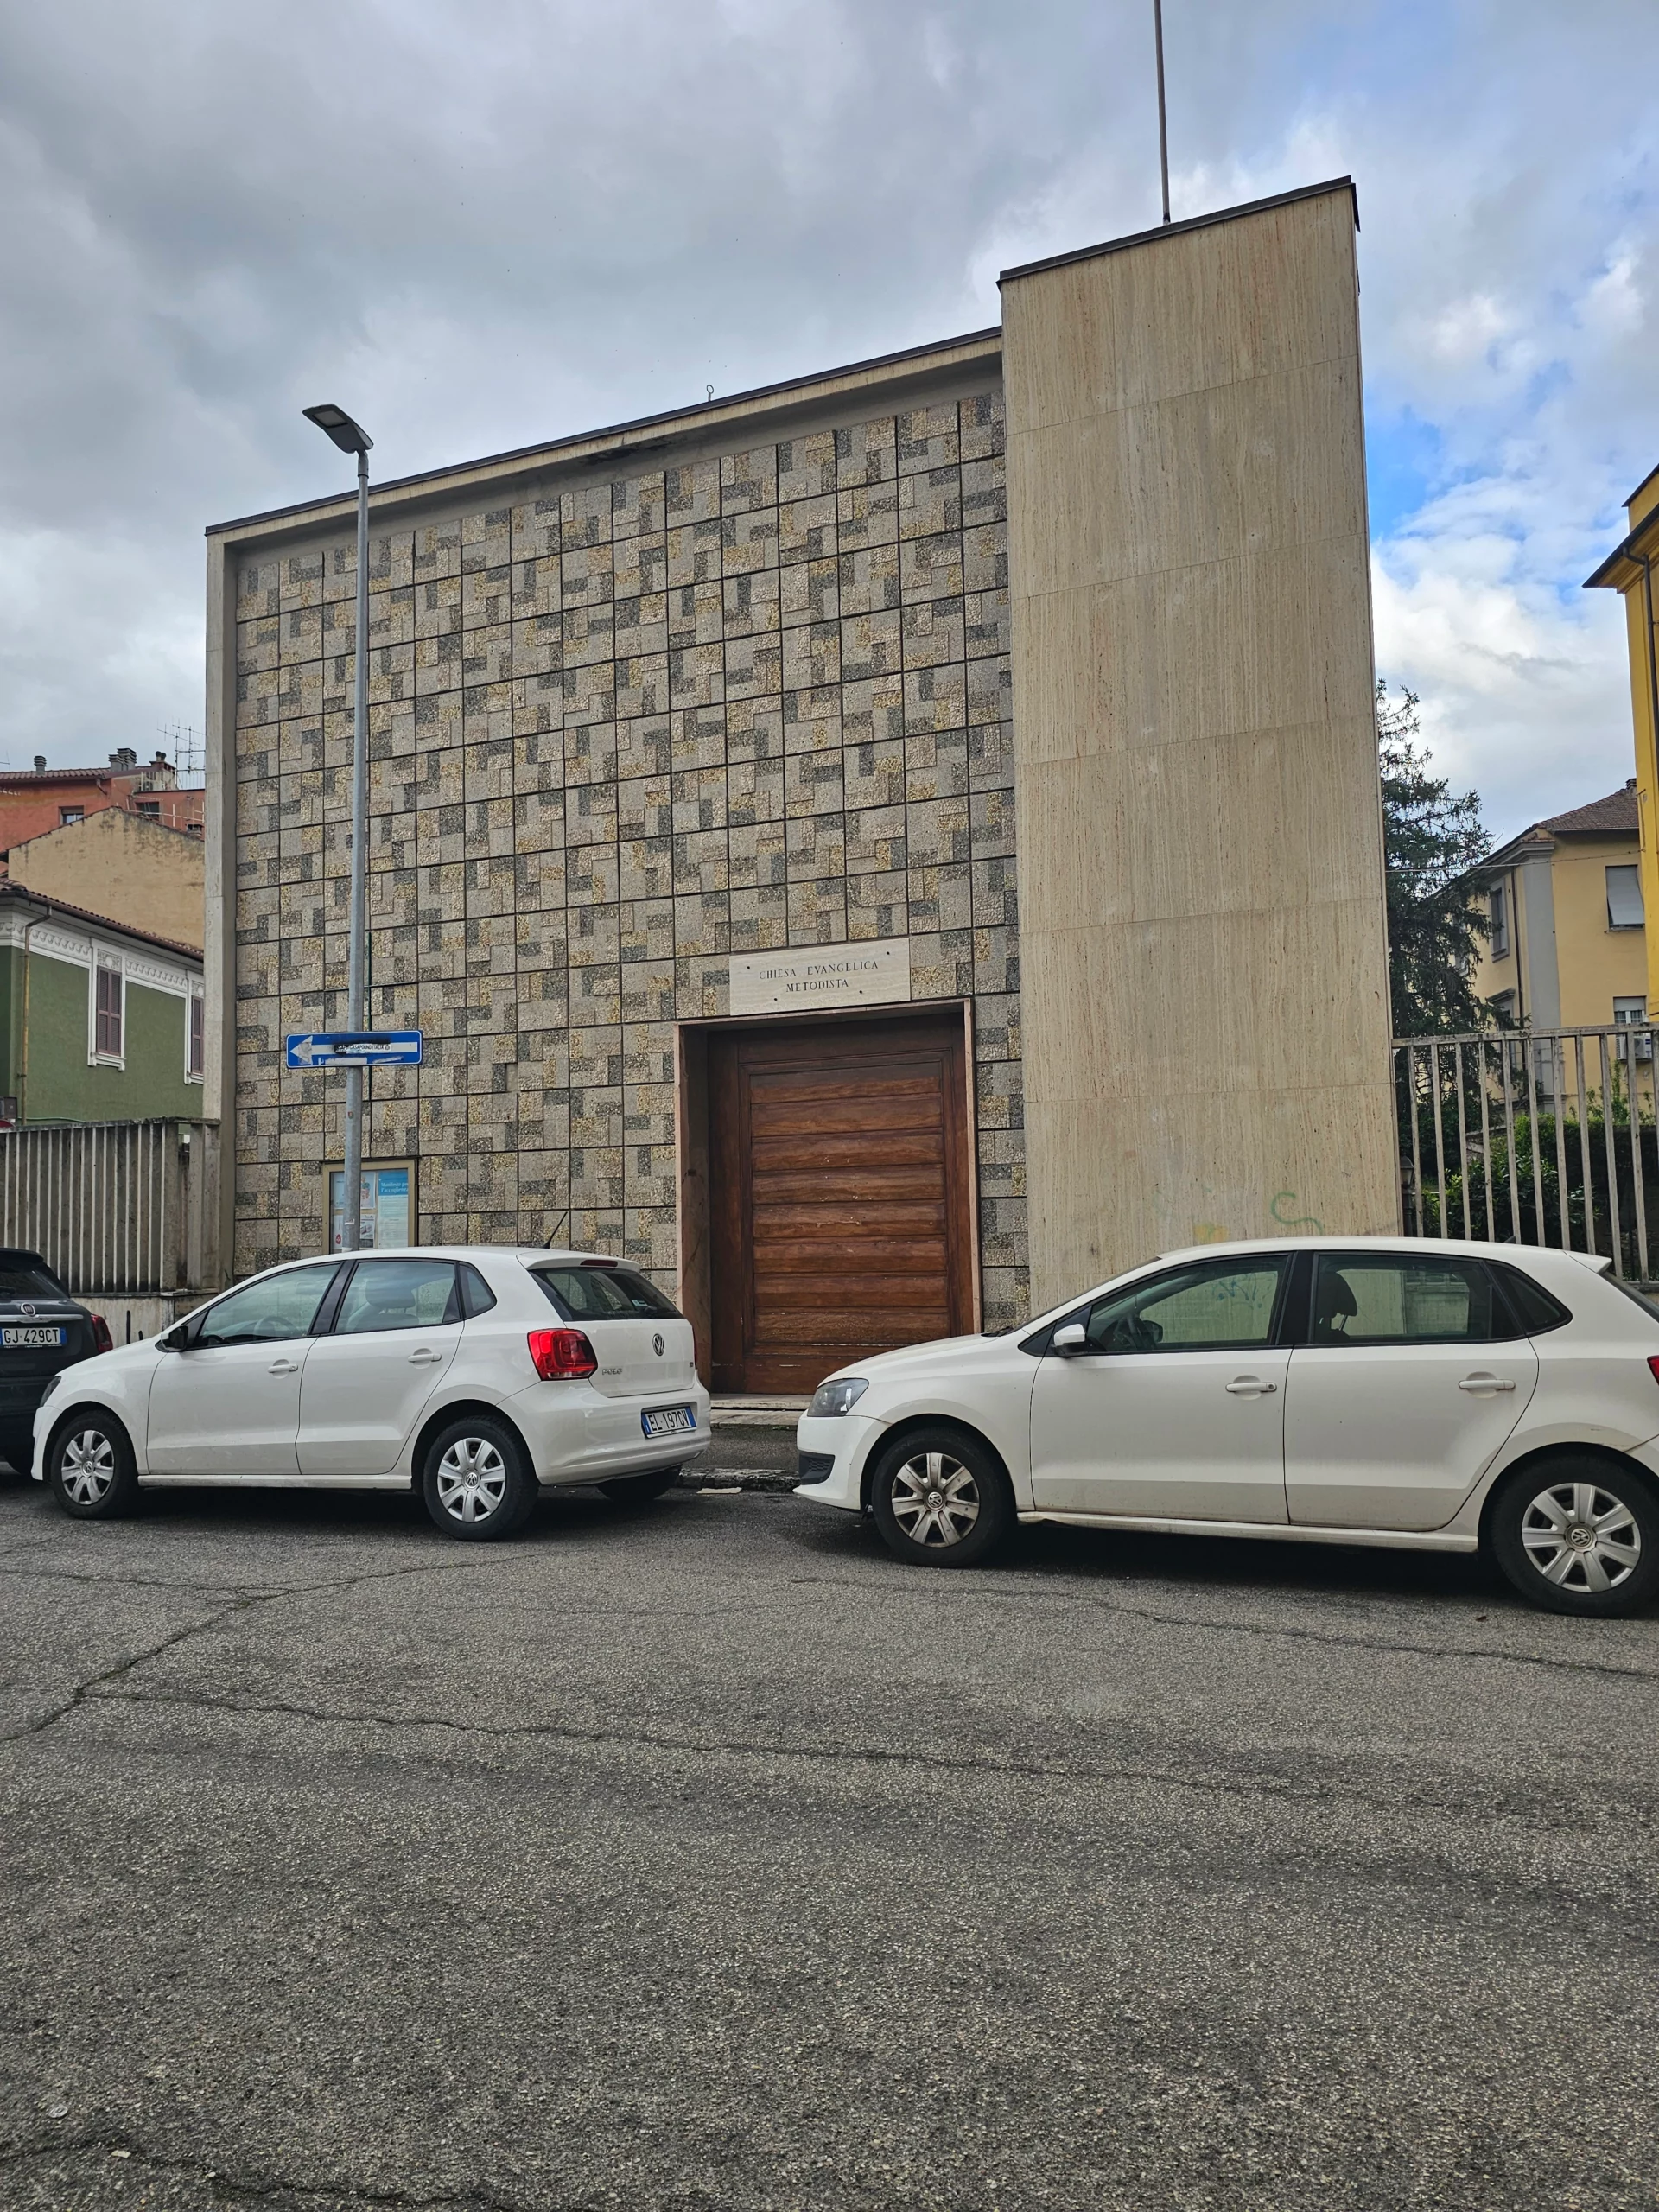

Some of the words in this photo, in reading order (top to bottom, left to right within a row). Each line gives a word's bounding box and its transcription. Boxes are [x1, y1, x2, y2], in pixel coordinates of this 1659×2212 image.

[759, 969, 797, 980] CHIESA
[807, 961, 878, 976] EVANGELICA
[786, 979, 849, 992] METODISTA
[3, 1329, 19, 1344] GJ
[24, 1329, 58, 1344] 429CT
